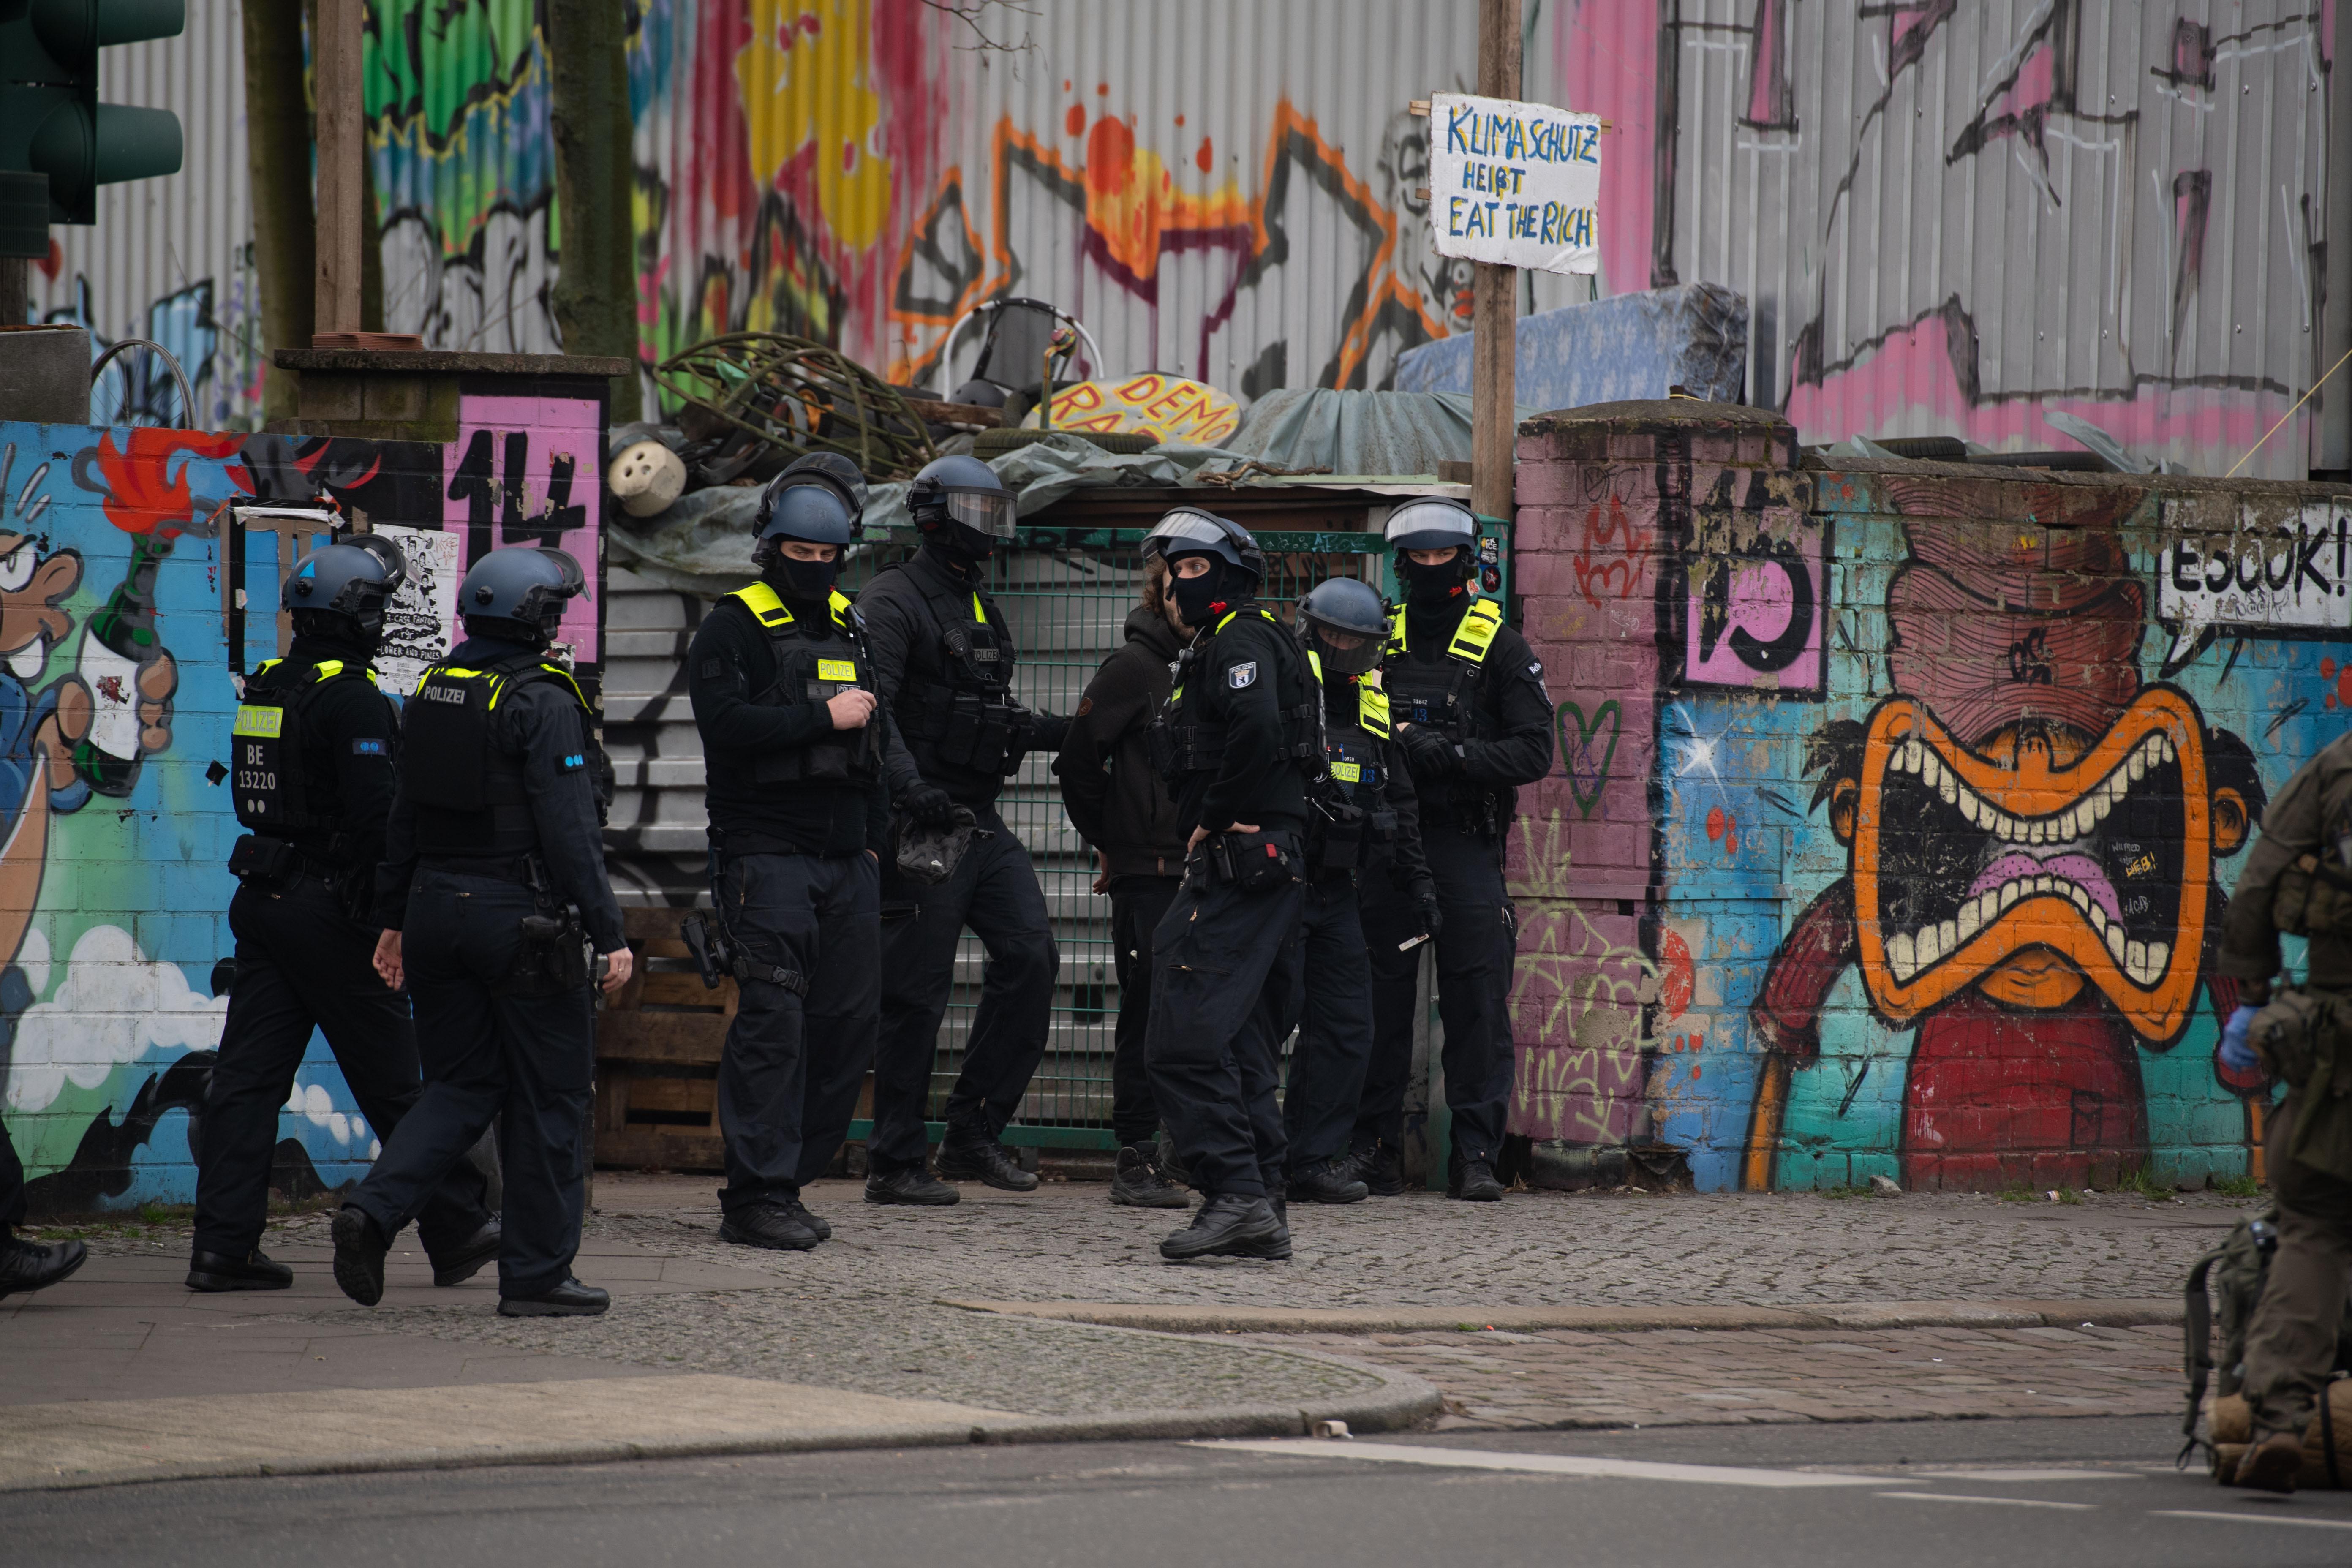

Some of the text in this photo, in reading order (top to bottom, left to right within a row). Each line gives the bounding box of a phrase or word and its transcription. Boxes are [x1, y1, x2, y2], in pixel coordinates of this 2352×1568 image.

[1448, 106, 1599, 163] KLIMASCHUTZ
[1450, 196, 1593, 249] EAT THE RICH
[821, 663, 853, 677] POLIZEI
[1231, 664, 1254, 674] POLIZEI
[424, 685, 465, 704] POLIZEI
[247, 744, 264, 765] BE
[239, 770, 275, 790] 13220
[1361, 769, 1375, 782] 13
[2129, 895, 2149, 914] ACAB
